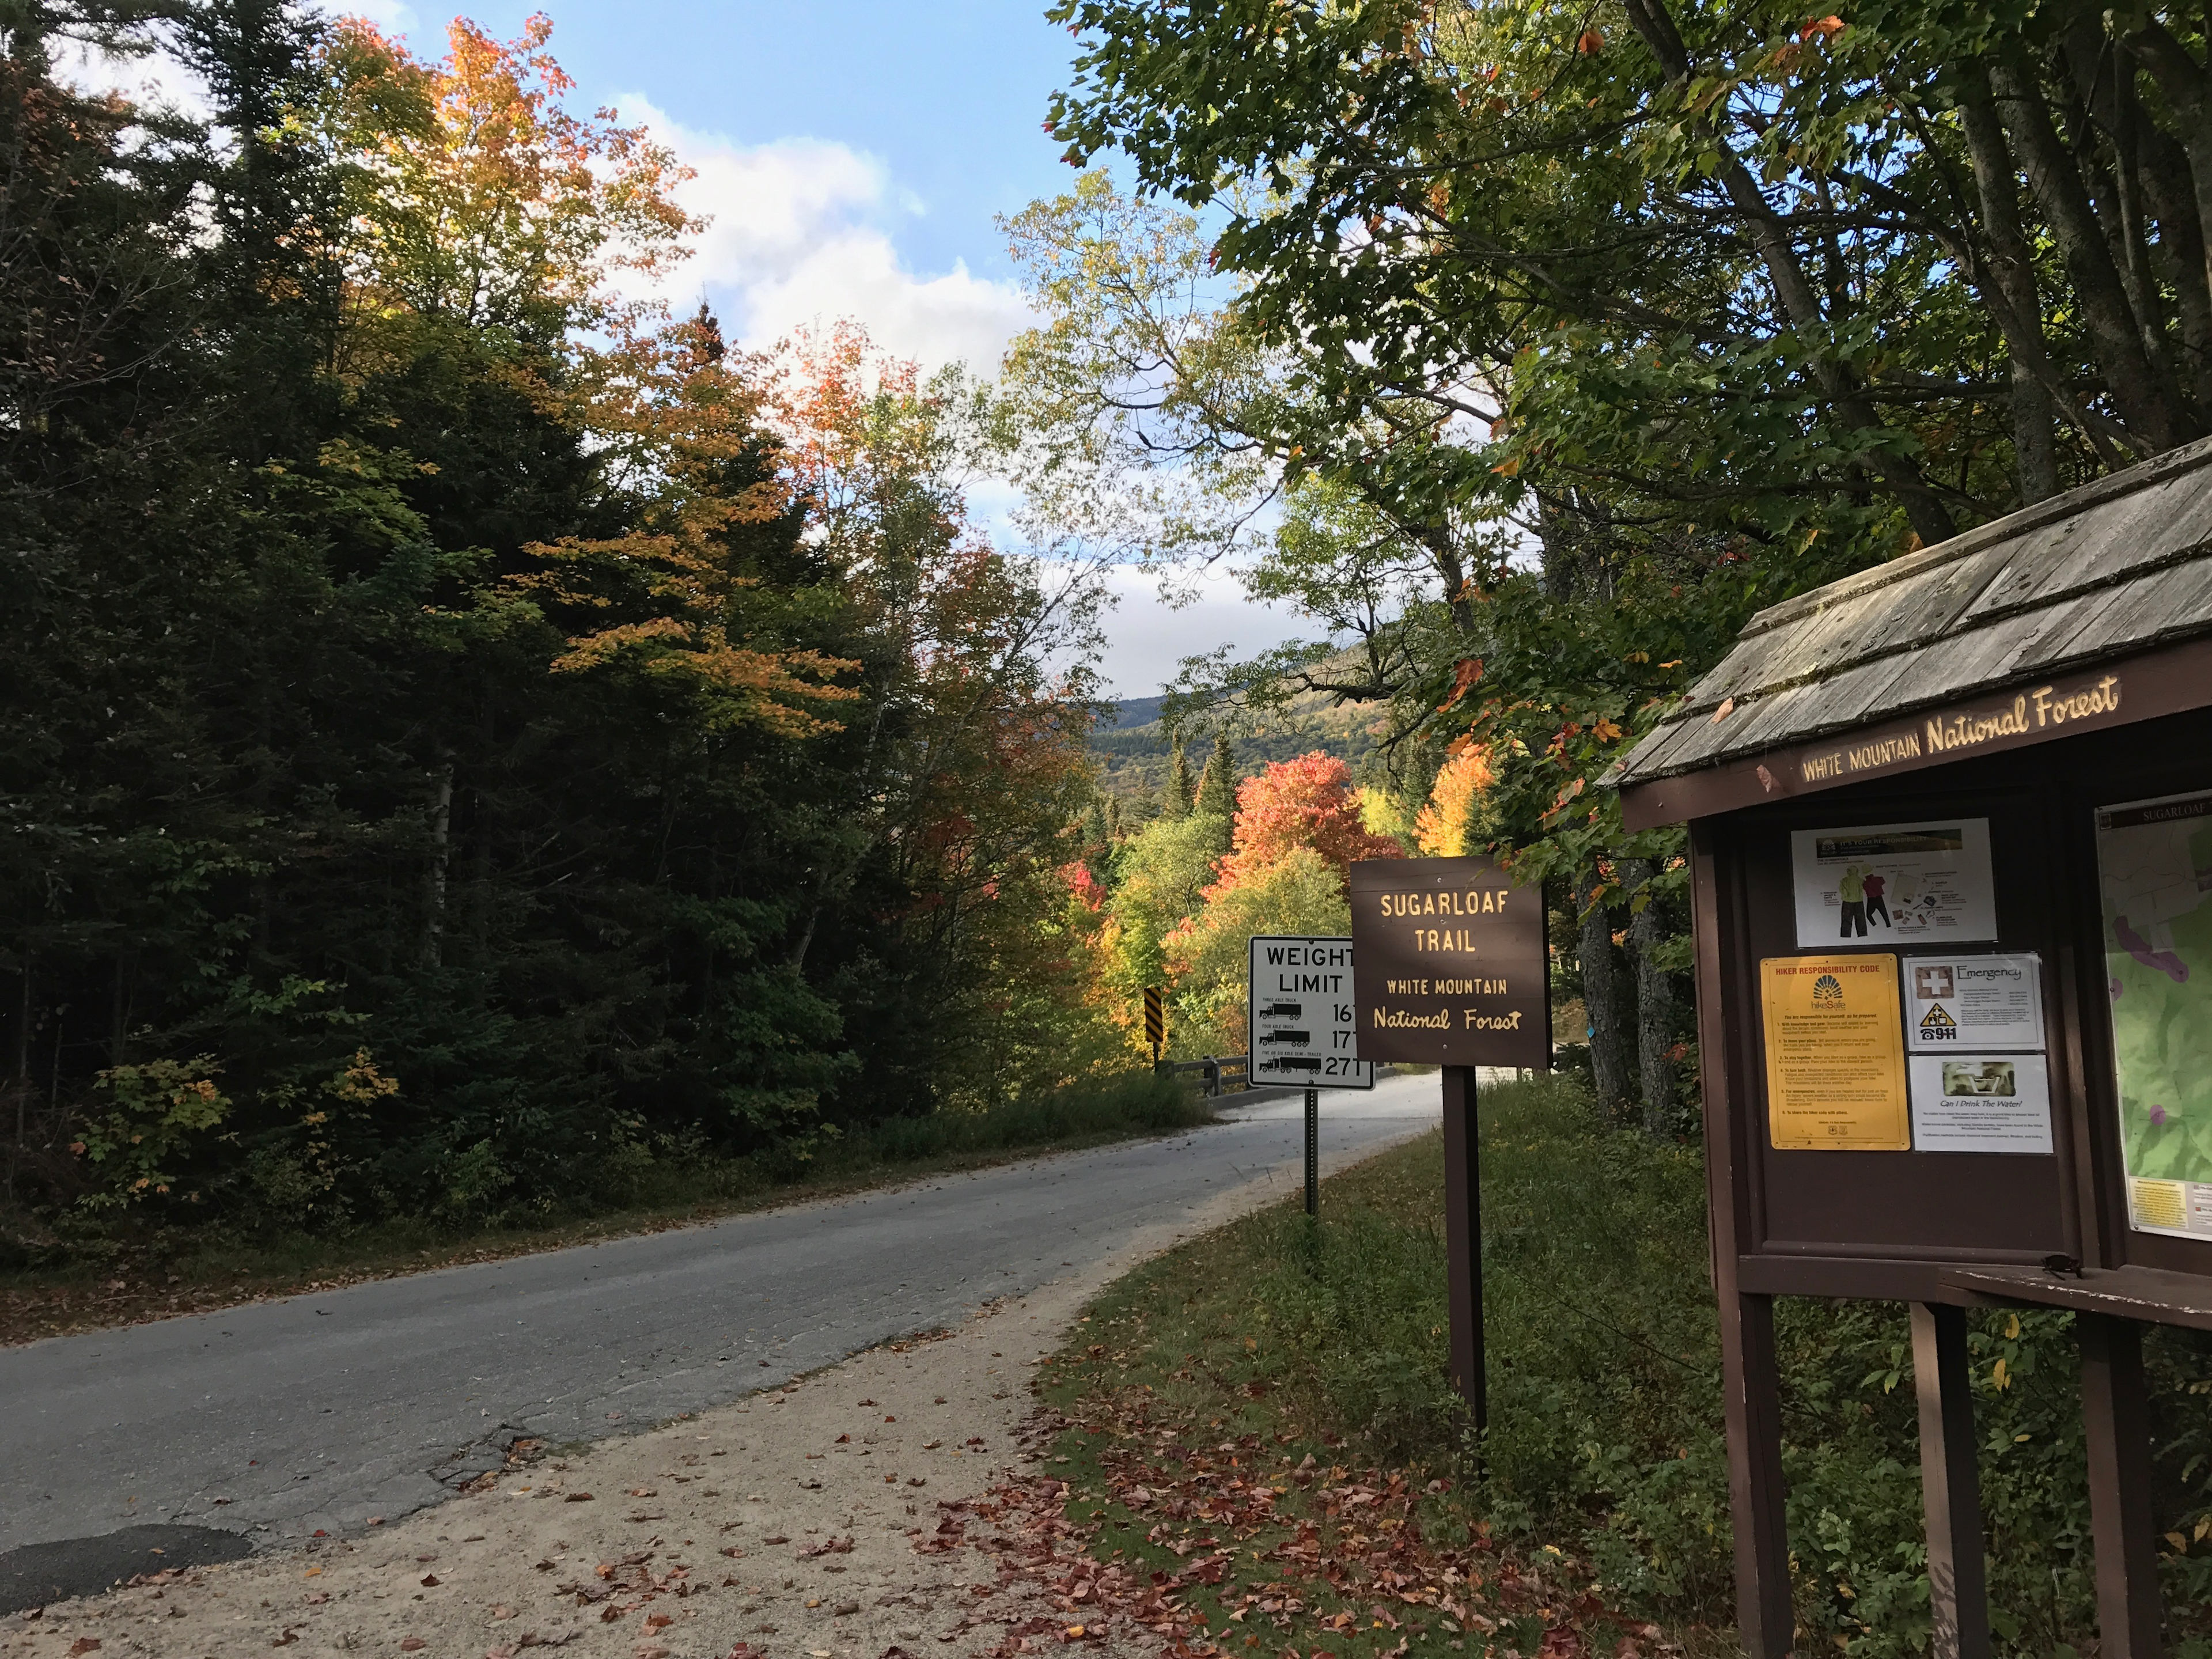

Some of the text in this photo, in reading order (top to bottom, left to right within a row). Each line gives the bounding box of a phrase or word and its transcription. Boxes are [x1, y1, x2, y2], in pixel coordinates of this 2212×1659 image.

[1803, 676, 2119, 781] WHITE MOUNTAIN National Forest
[2143, 803, 2206, 821] SUGARLOAF
[1874, 836, 1927, 844] RESPONSIBILITY
[1380, 891, 1508, 916] SUGARLOAF
[1414, 929, 1475, 952] TRAIL
[1267, 947, 1354, 967] WEIGHT
[1800, 965, 1858, 974] RESPONSIBILITY
[1860, 965, 1880, 973] CODE
[1957, 965, 2021, 980] Emergency
[1279, 974, 1343, 993] LIMIT
[1387, 978, 1507, 995] WHITE MOUNTAIN
[1334, 1004, 1355, 1022] 16
[1811, 1000, 1846, 1009] hikeSafe
[1374, 1006, 1522, 1030] National Forest
[1333, 1030, 1356, 1049] 17
[1936, 1027, 1957, 1040] 911
